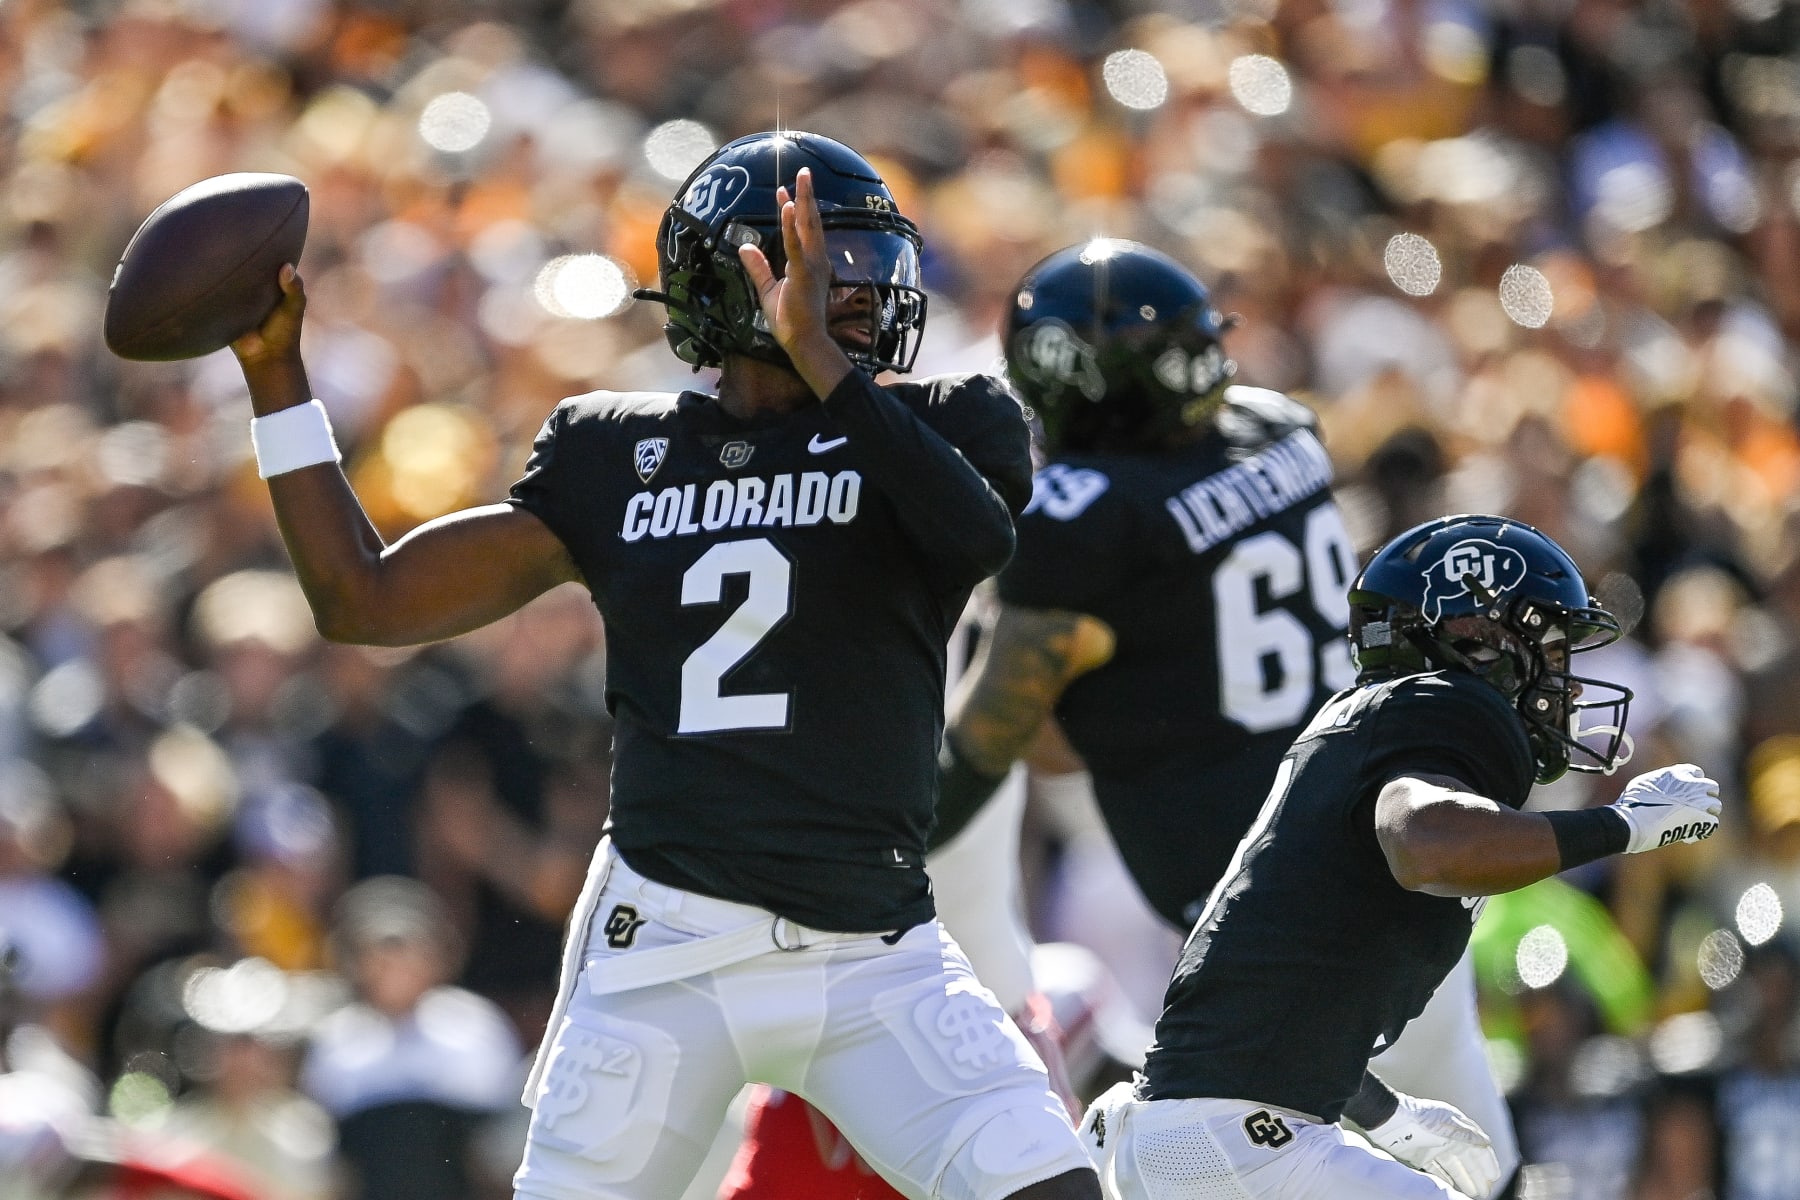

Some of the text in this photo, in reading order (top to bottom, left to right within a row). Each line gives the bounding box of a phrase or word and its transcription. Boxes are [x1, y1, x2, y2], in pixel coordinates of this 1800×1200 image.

[636, 439, 668, 466] PAC
[640, 455, 656, 473] 12
[621, 470, 862, 543] COLORADO
[677, 537, 792, 734] 2
[1212, 502, 1357, 733] 69
